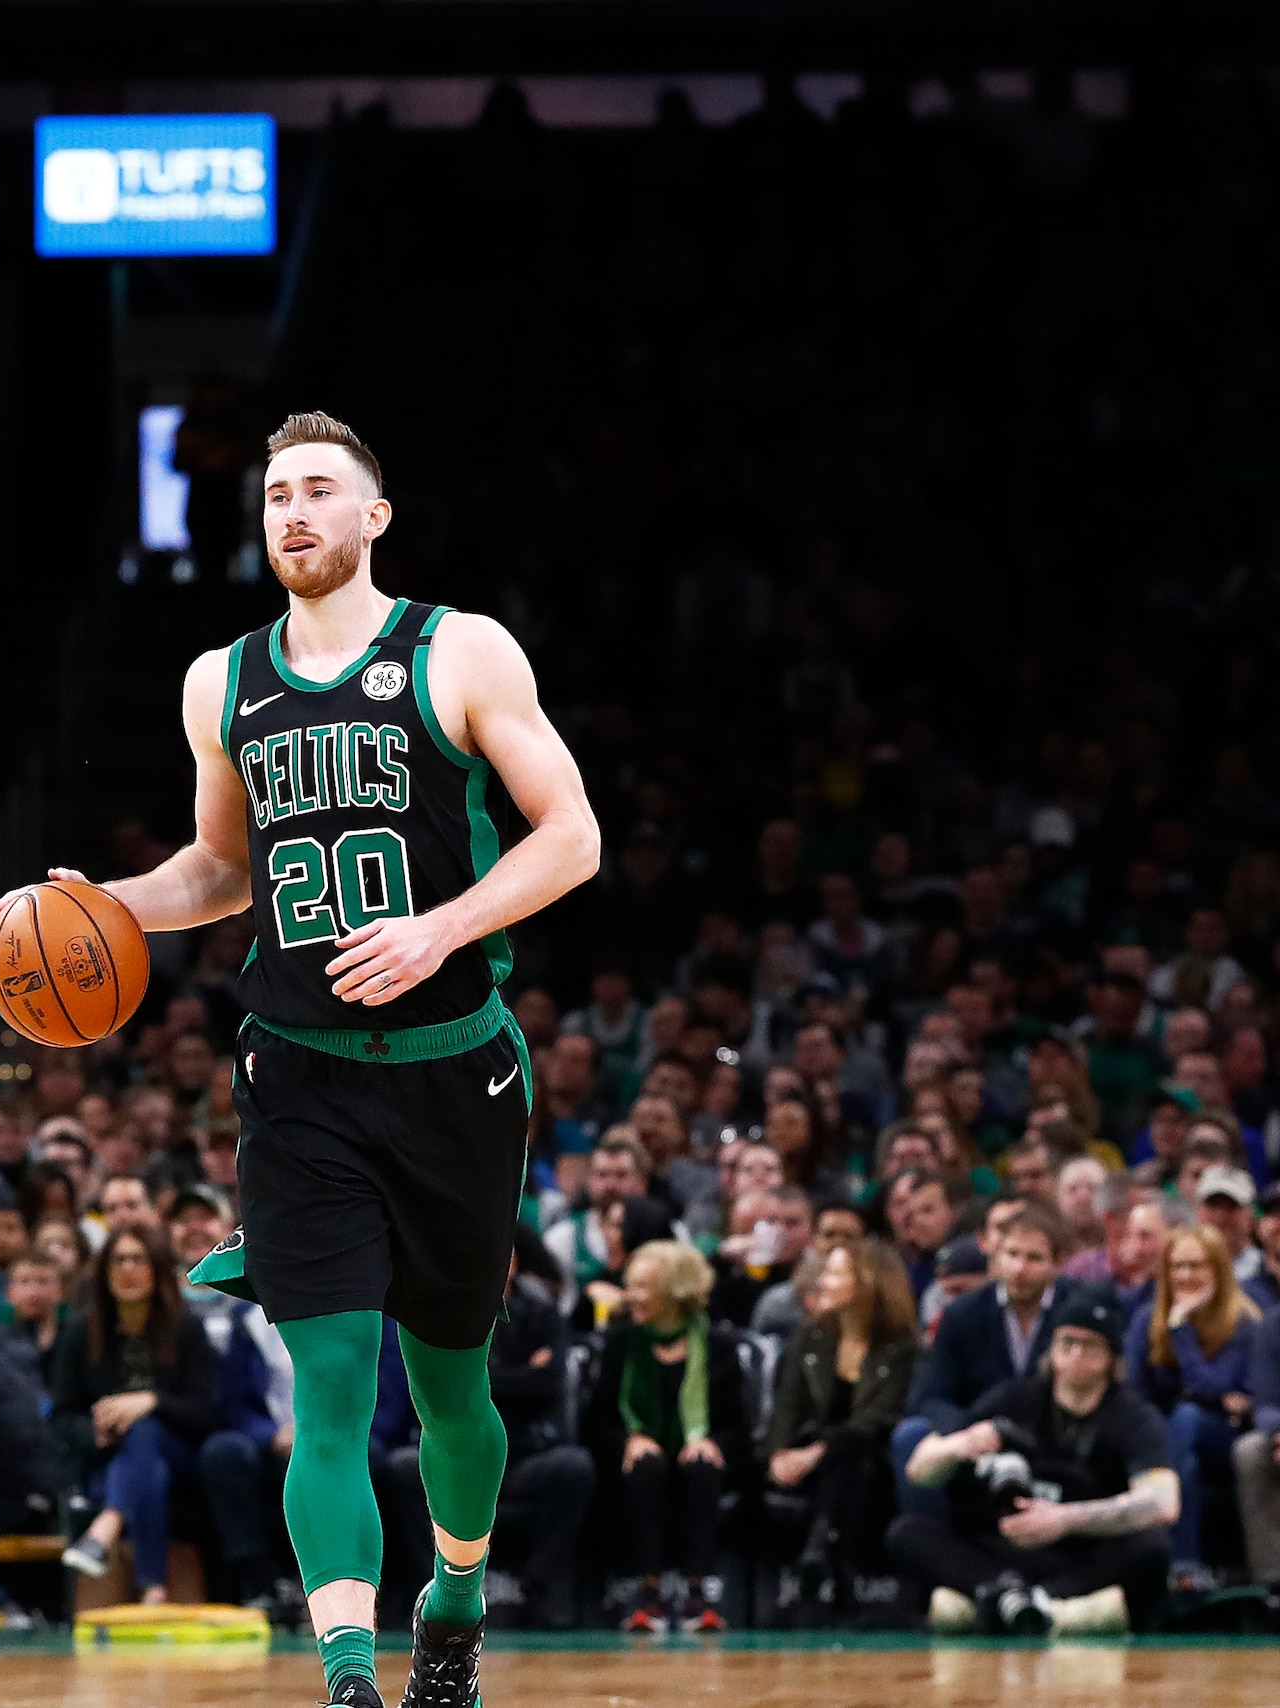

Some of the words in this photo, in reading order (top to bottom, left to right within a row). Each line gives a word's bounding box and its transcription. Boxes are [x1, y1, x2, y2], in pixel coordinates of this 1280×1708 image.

[119, 149, 266, 193] TUFTS
[241, 722, 410, 829] CELTICS
[269, 829, 414, 948] 20
